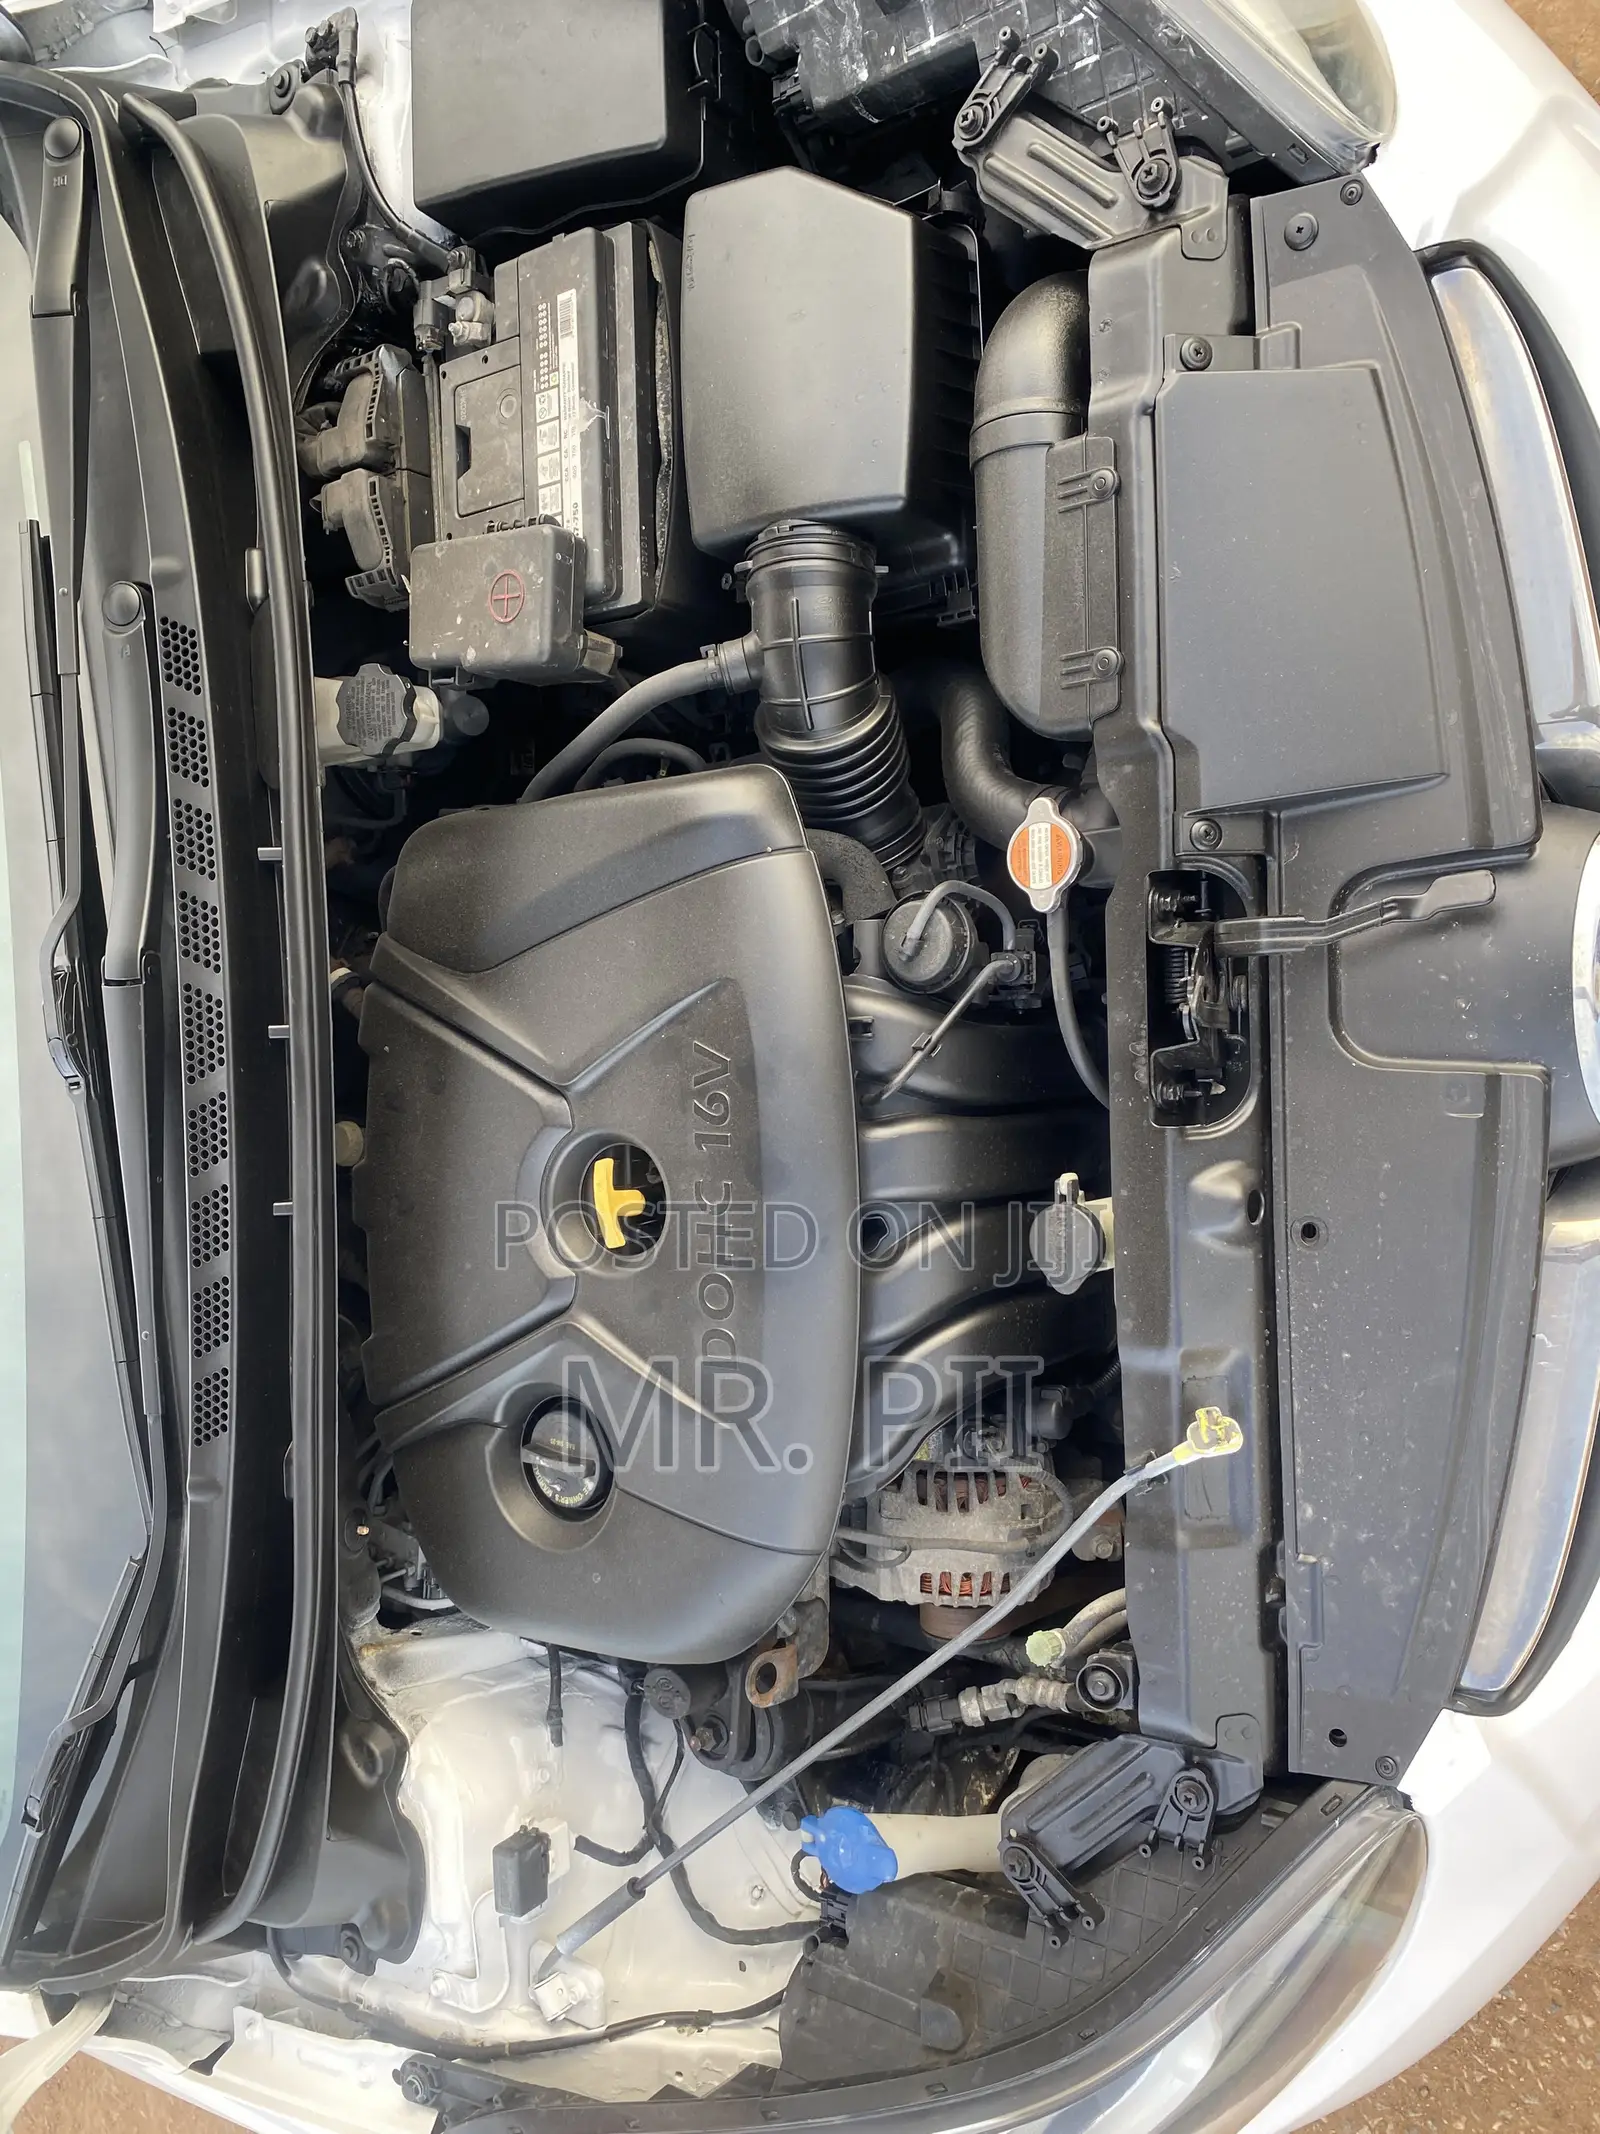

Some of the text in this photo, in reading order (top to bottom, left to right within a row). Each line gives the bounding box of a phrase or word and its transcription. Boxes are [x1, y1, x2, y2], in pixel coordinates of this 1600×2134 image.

[693, 1040, 738, 1370] DOHC 16V
[533, 1465, 554, 1498] MANUAL
[555, 1493, 583, 1505] OWNER'S
